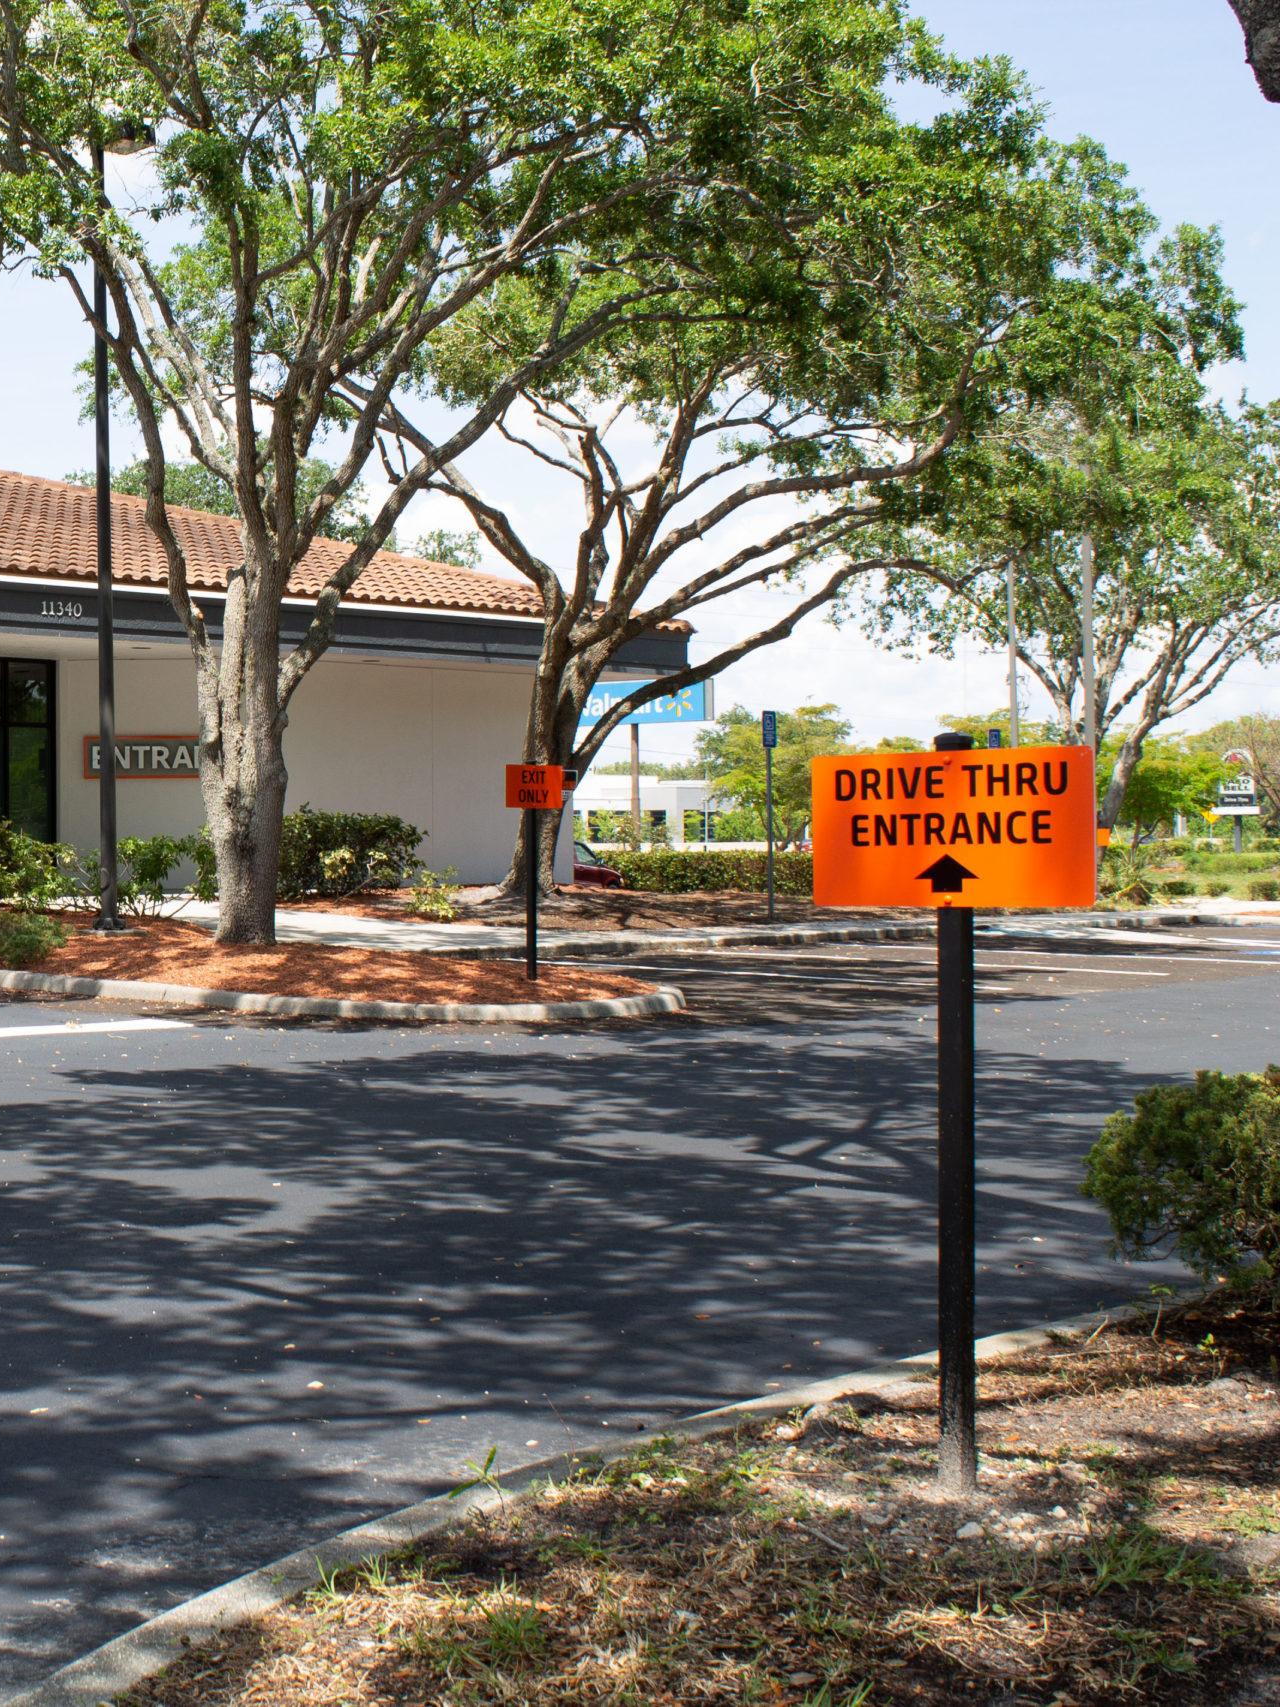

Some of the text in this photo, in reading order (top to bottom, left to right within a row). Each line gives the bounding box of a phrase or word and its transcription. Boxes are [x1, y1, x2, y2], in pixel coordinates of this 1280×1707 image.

[41, 600, 83, 617] 11340
[521, 770, 546, 784] EXIT
[835, 761, 1068, 801] DRIVE THRU
[518, 788, 549, 803] ONLY
[851, 810, 1053, 847] ENTRANCE
